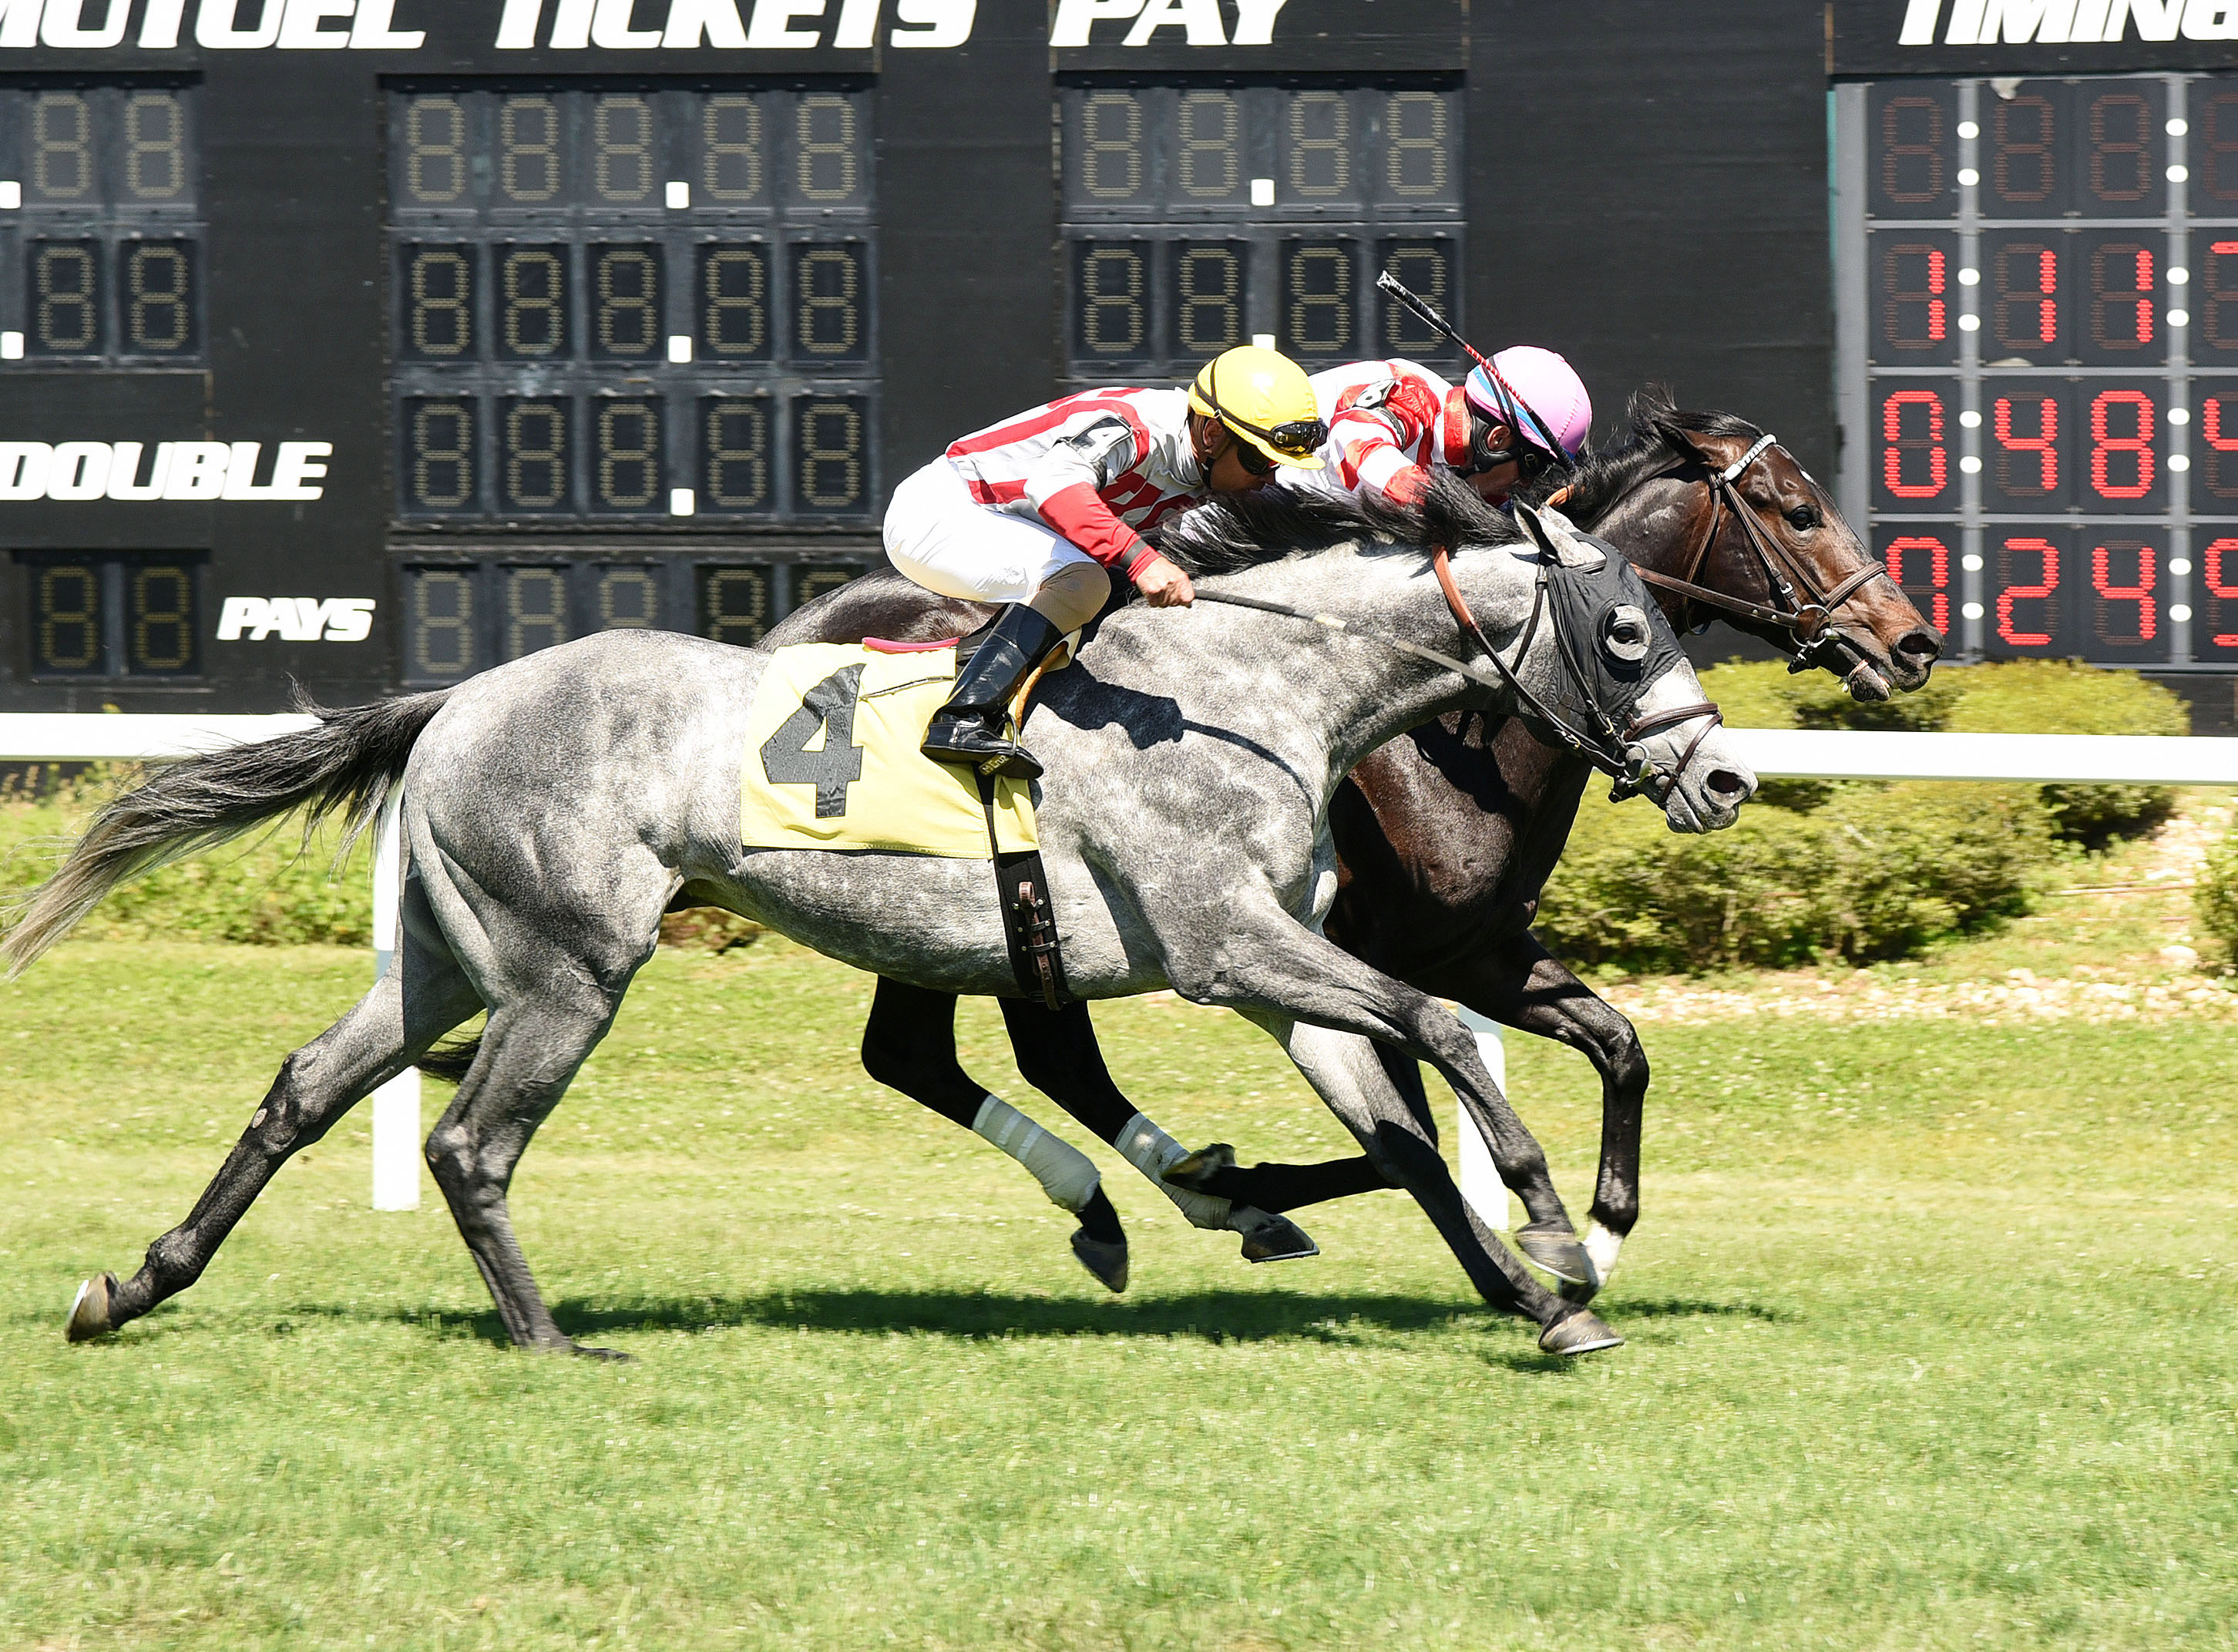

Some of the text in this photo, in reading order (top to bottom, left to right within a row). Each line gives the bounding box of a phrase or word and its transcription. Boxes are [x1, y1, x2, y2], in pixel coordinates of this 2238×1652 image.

[1048, 0, 1287, 47] PAY
[0, 441, 333, 501] DOUBLE
[216, 596, 376, 642] PAYS
[760, 663, 867, 819] 4
